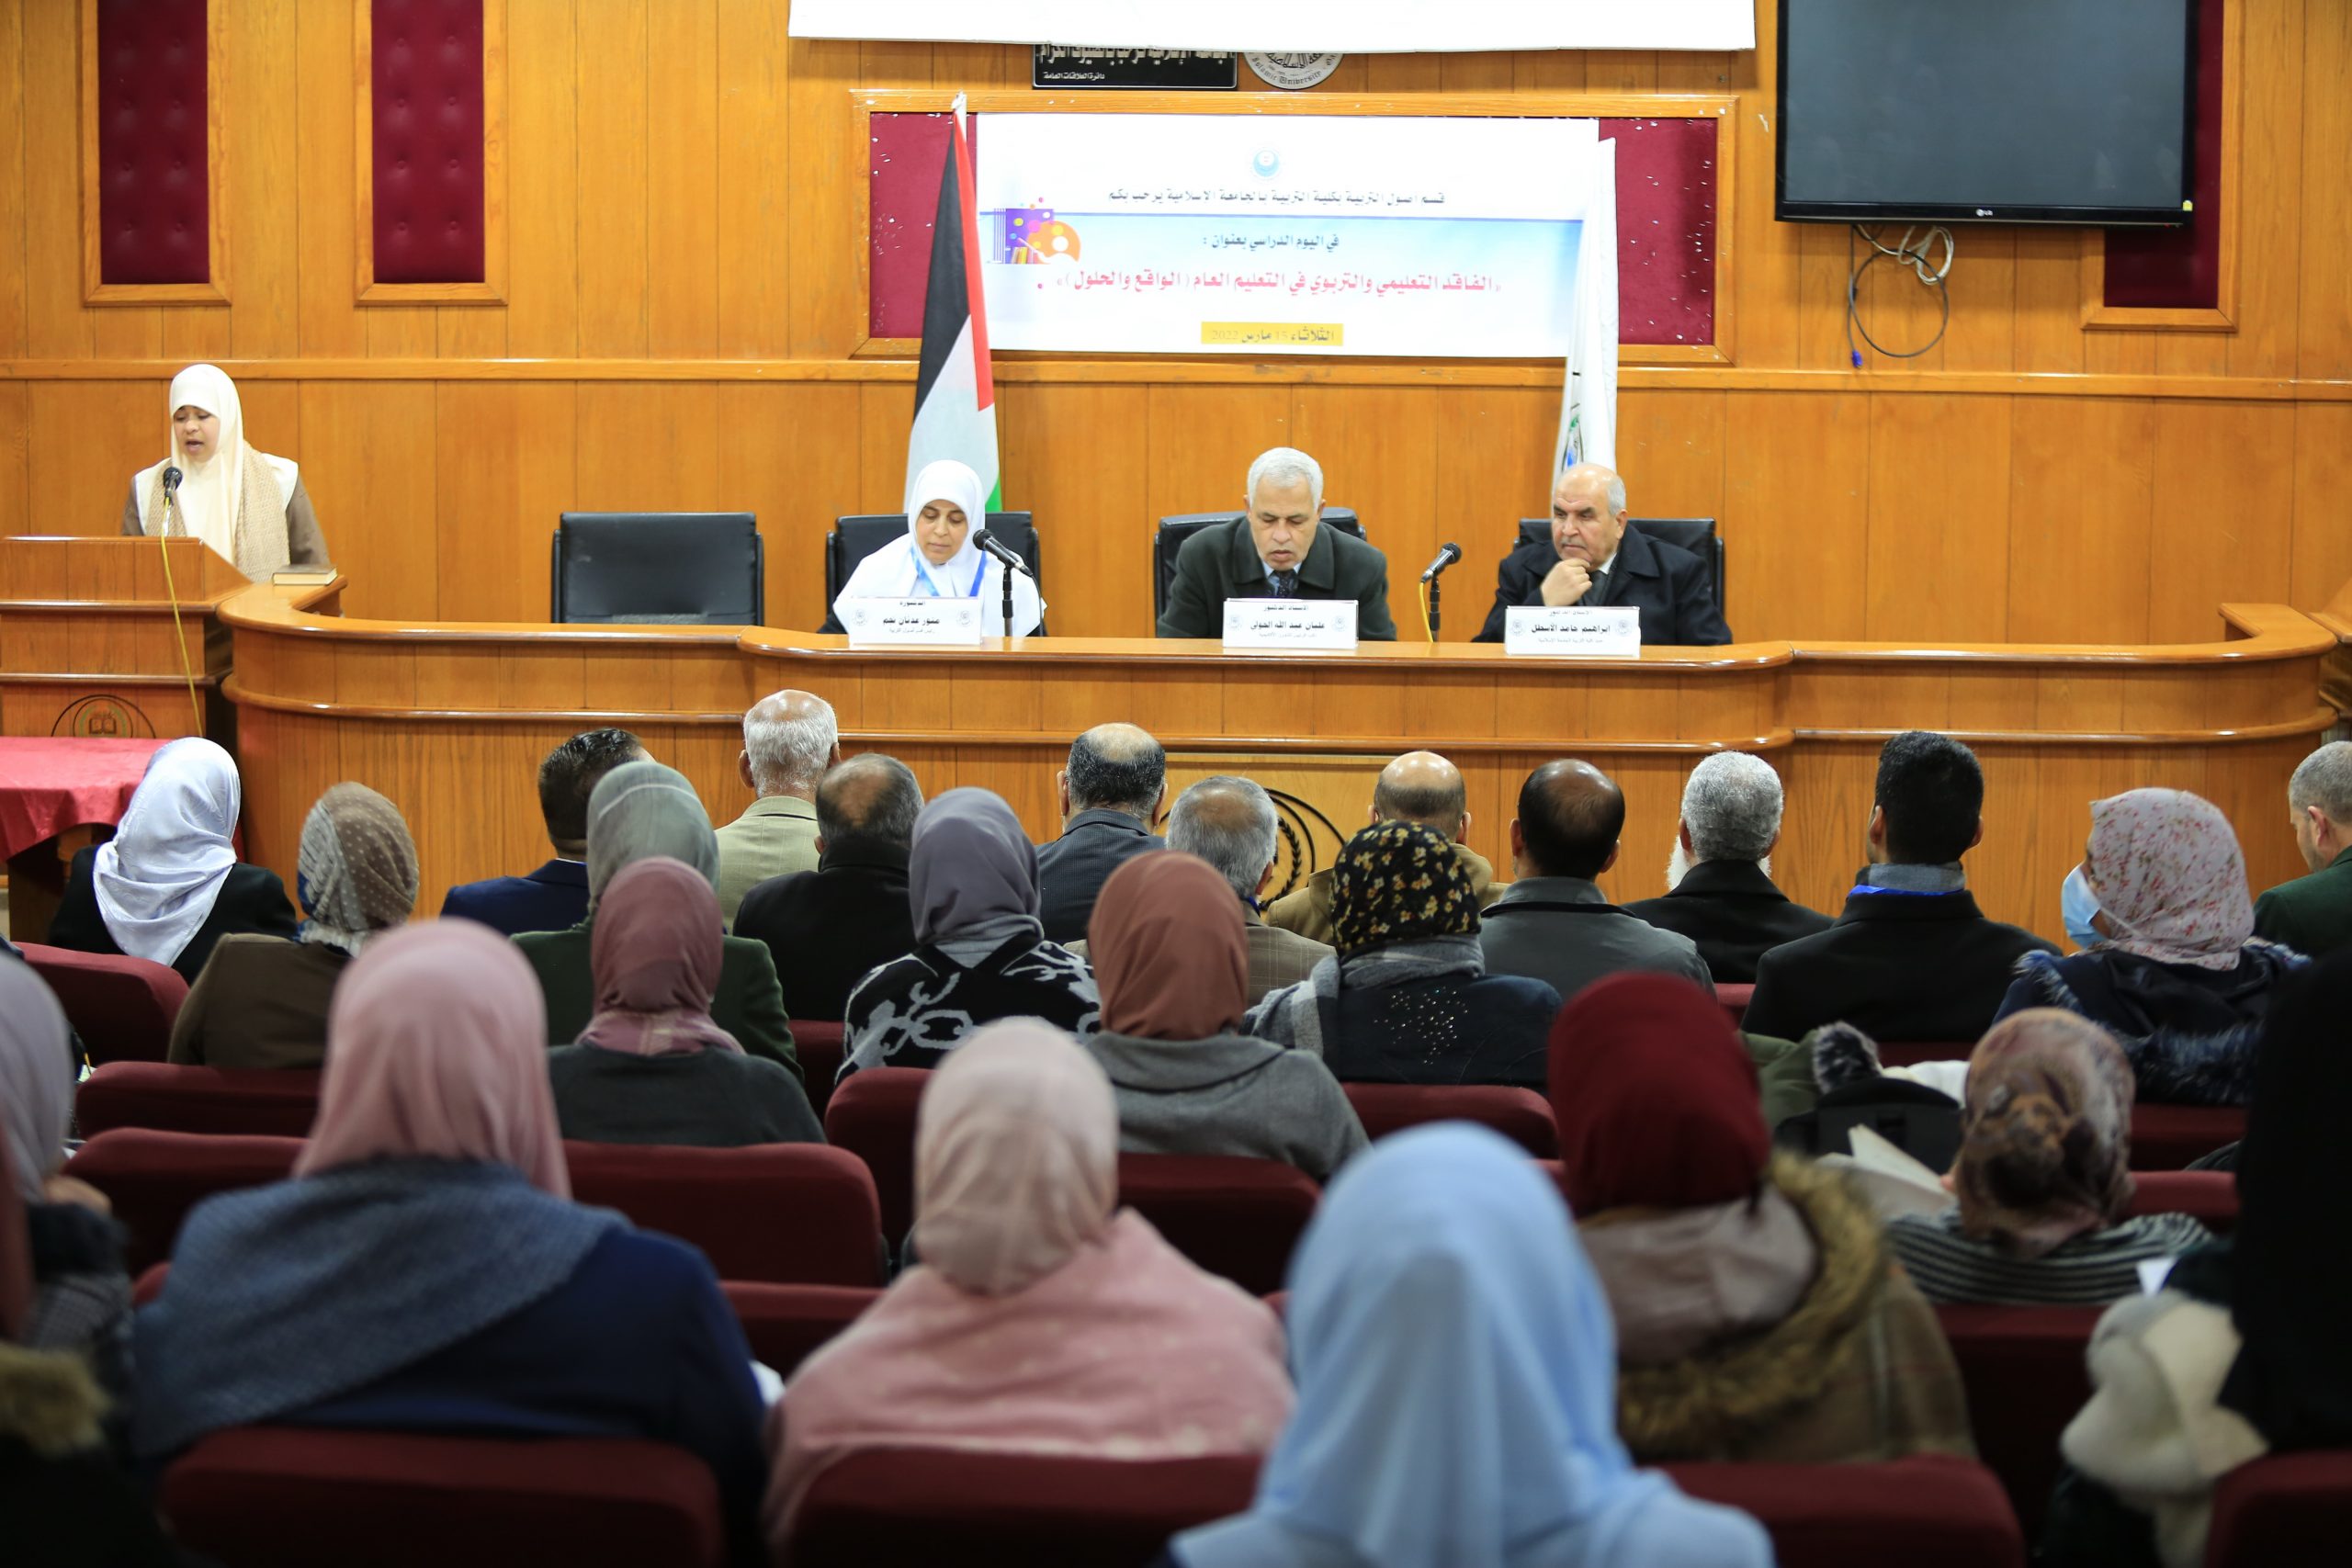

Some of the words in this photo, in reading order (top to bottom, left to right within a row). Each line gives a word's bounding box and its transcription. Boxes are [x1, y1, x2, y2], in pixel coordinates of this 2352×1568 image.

[1108, 188, 1128, 204] بكم
[1132, 191, 1163, 204] يرحب
[1219, 188, 1267, 205] بالجامعة
[1272, 189, 1309, 205] التربية
[1313, 189, 1341, 206] بكلية
[1346, 190, 1385, 206] التربية
[1421, 192, 1445, 205] قسم
[1212, 233, 1248, 250] بعنوان
[1250, 234, 1294, 252] الدراسي
[1296, 234, 1324, 250] اليوم
[1327, 233, 1340, 253] في
[1193, 272, 1229, 289] العام
[1234, 272, 1285, 292] التعليم
[1289, 271, 1306, 296] في
[1310, 272, 1373, 295] والتربوي
[1375, 274, 1439, 297] التعليمي
[1241, 330, 1272, 344] مارس
[1291, 325, 1335, 342] الثلاثاء
